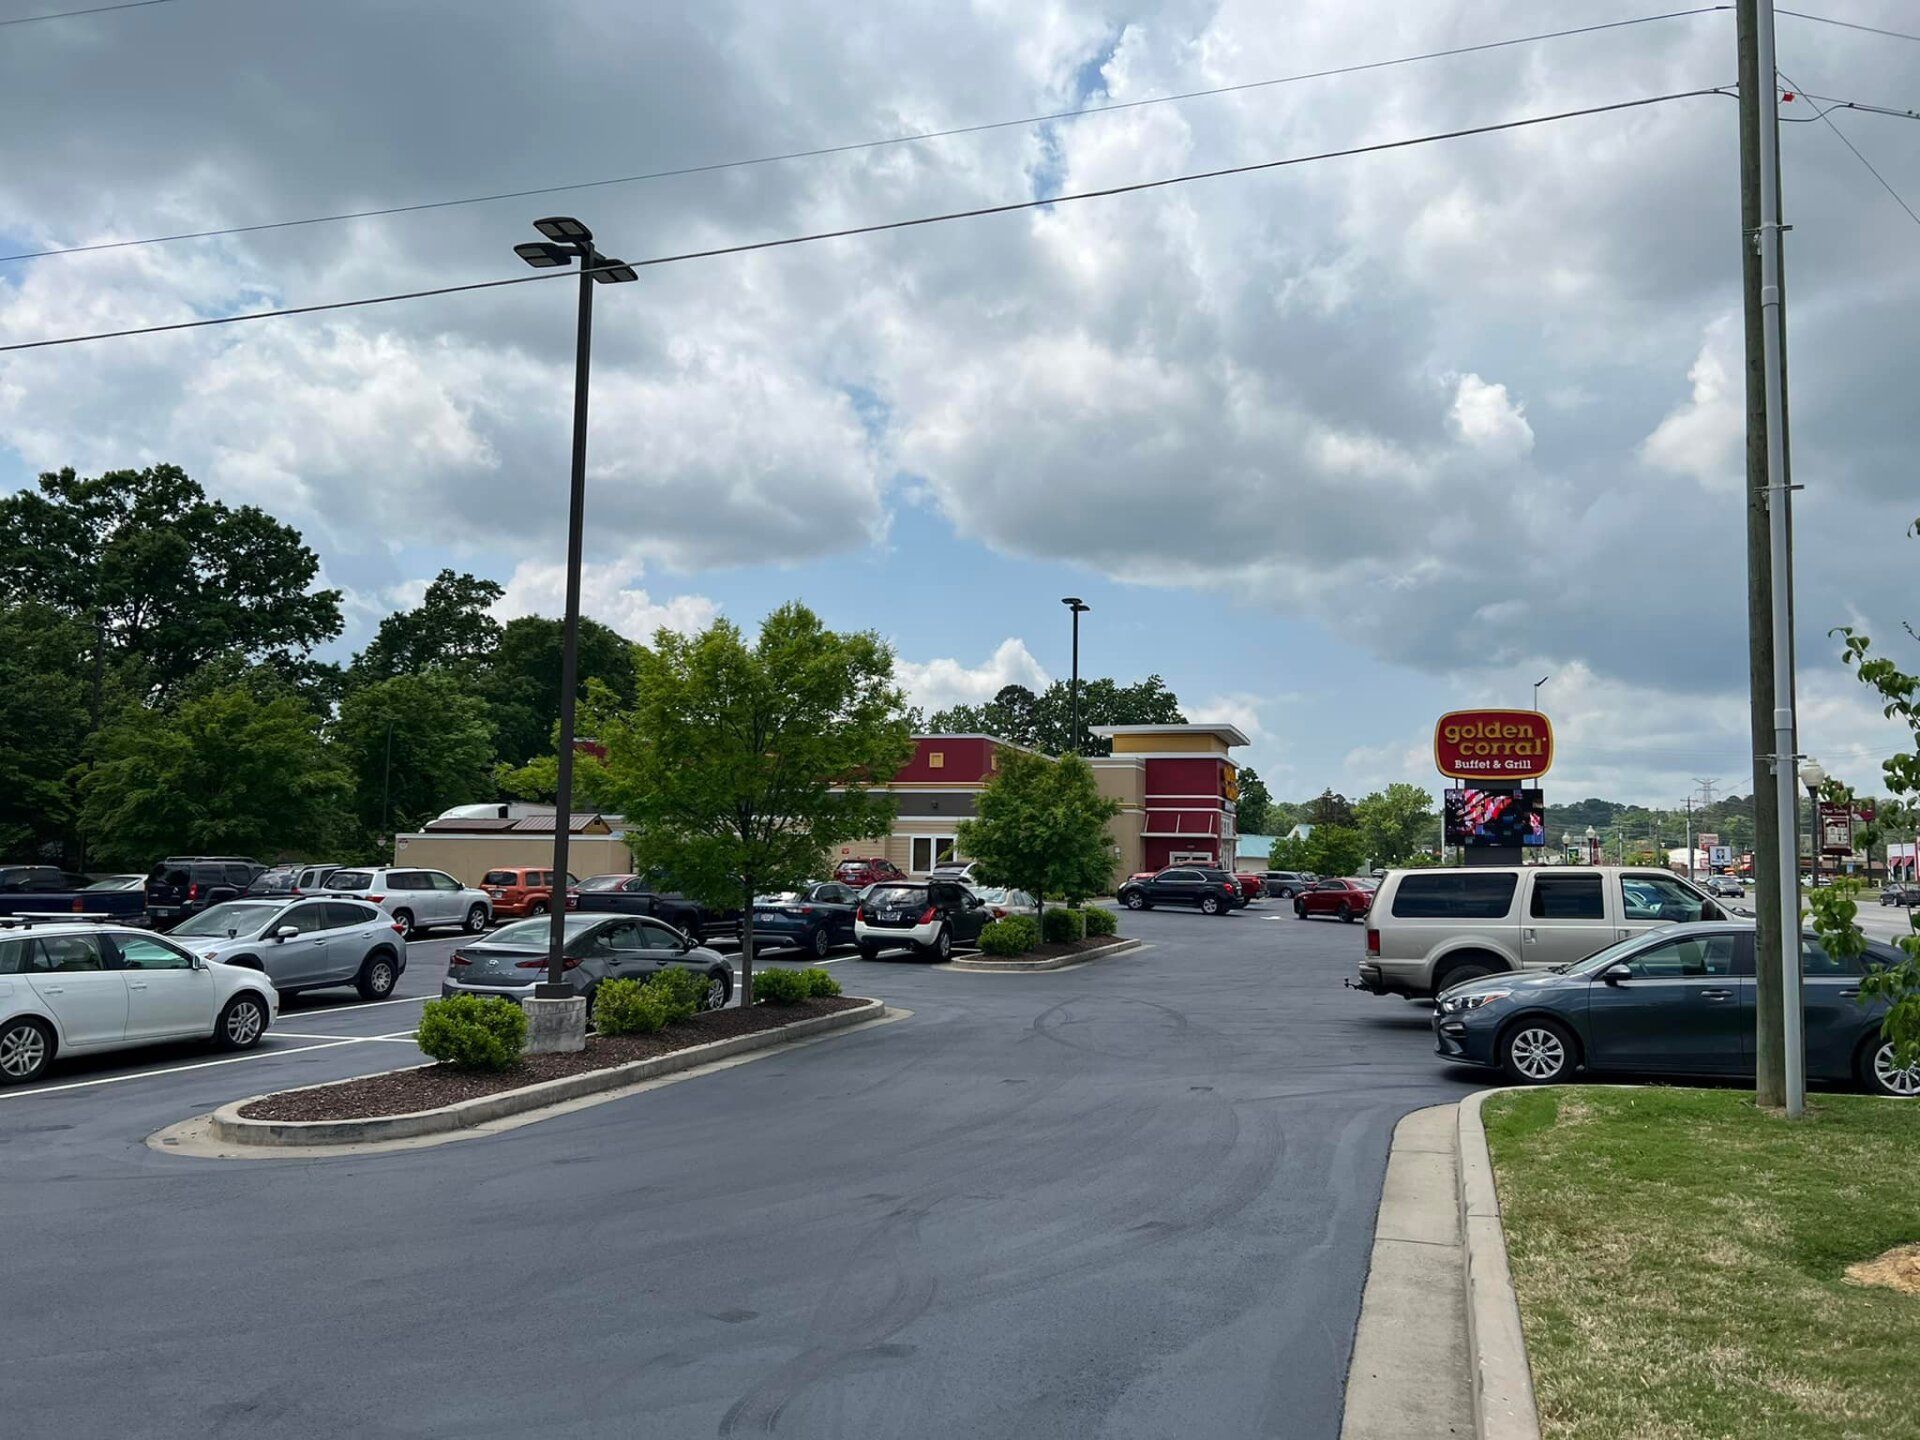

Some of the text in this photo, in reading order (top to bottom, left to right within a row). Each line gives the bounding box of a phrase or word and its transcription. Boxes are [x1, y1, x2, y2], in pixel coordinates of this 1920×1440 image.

[1445, 720, 1534, 744] golden
[1459, 738, 1543, 756] corral
[1454, 759, 1532, 769] Buffet & Grill
